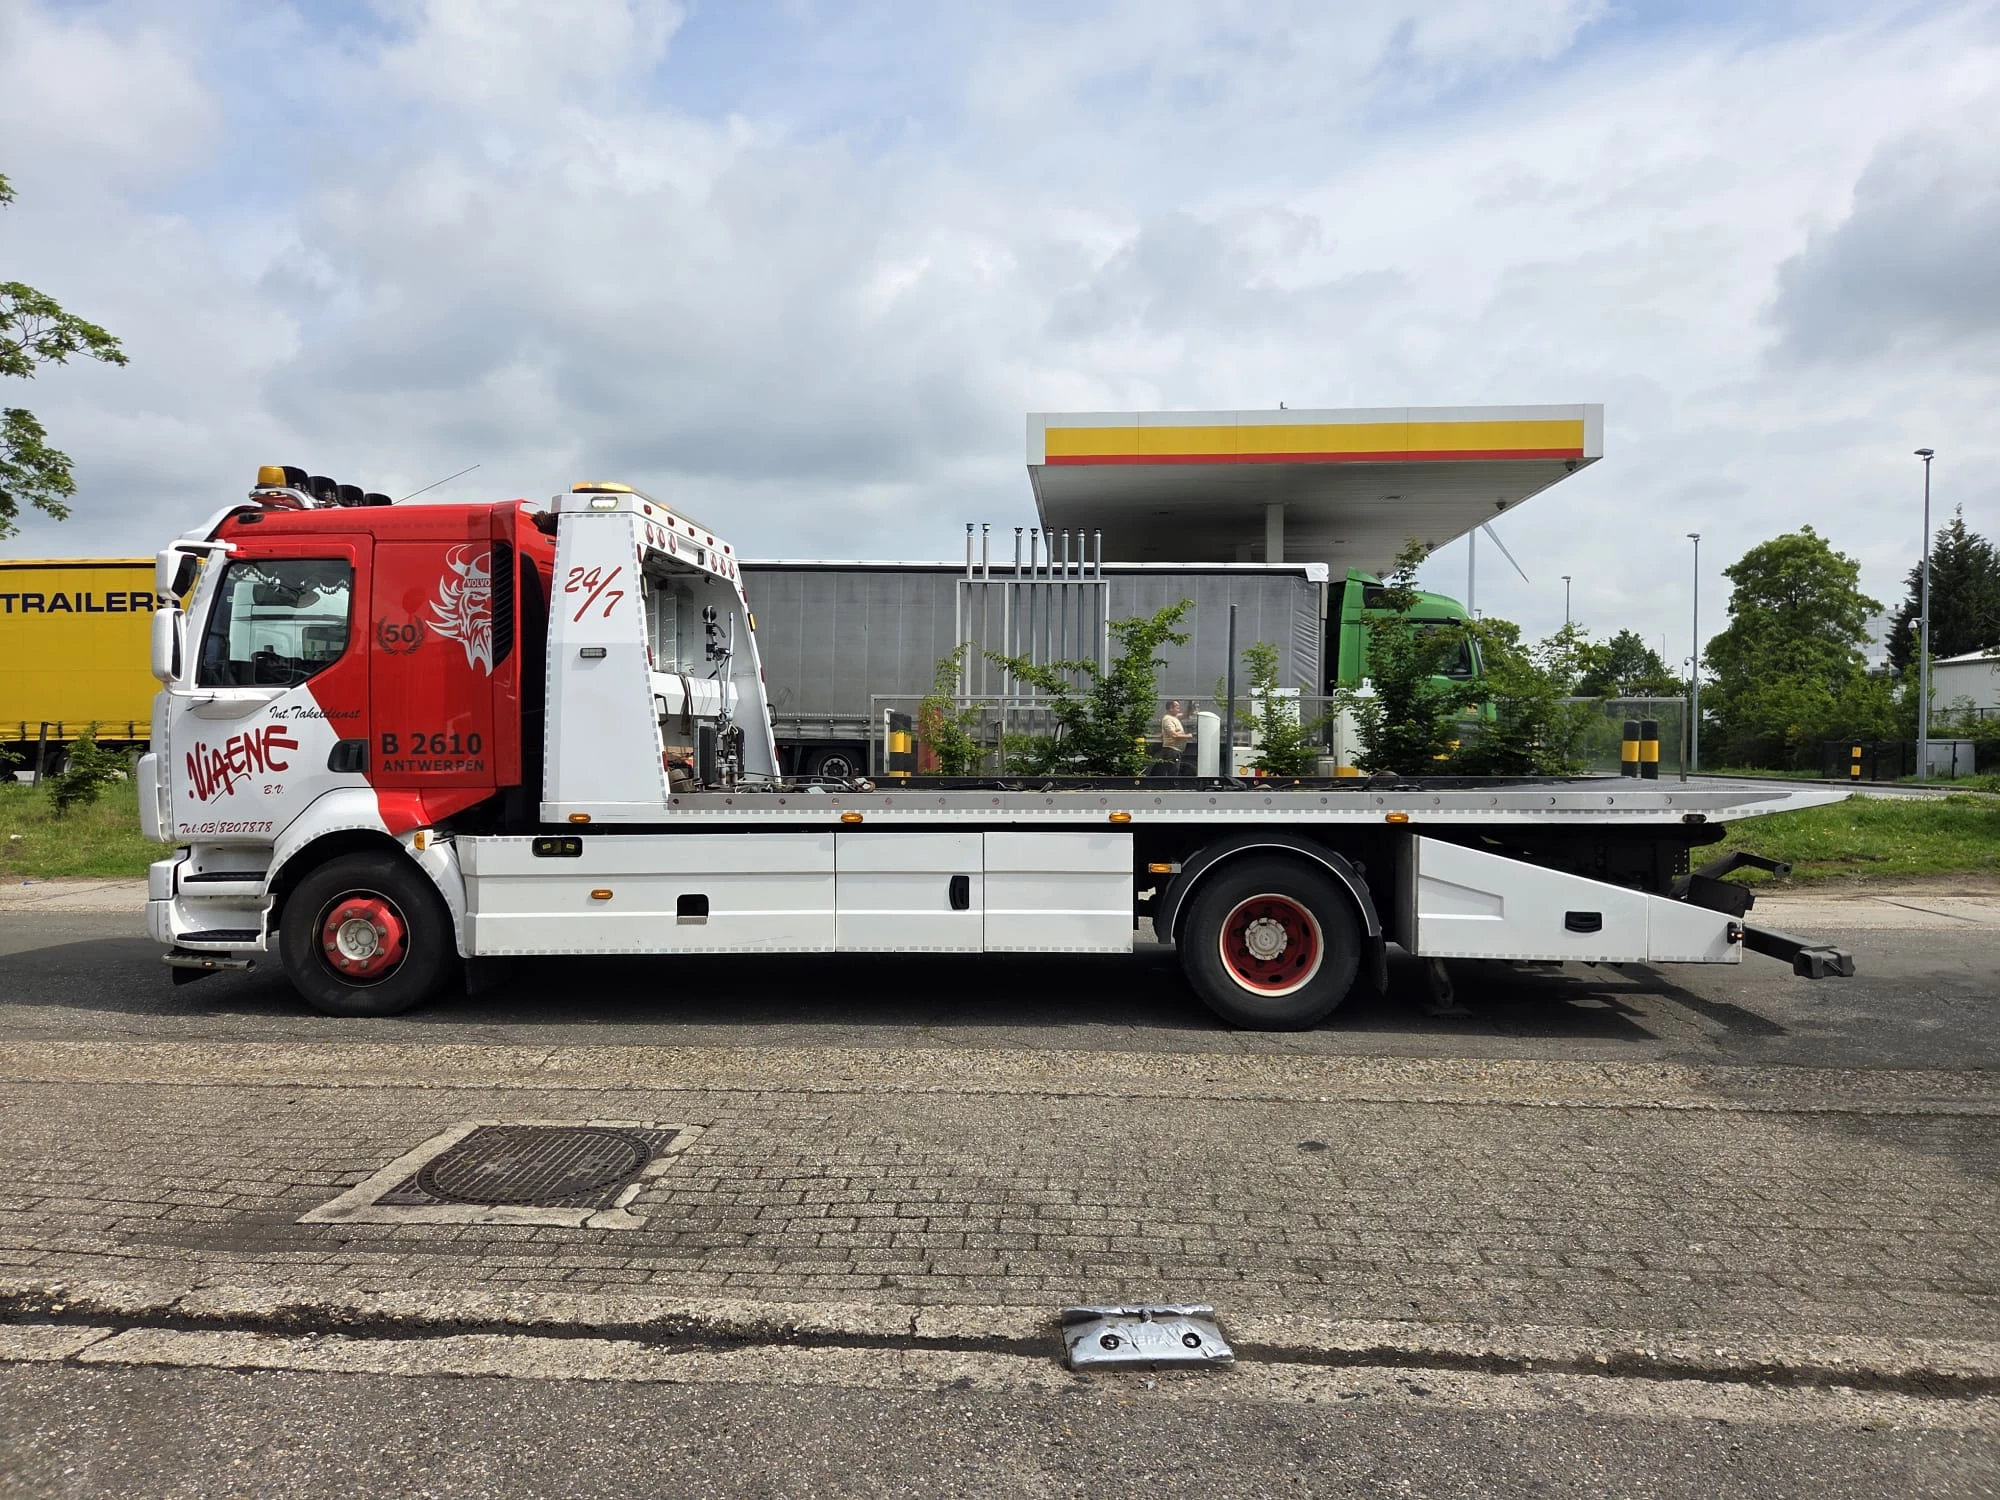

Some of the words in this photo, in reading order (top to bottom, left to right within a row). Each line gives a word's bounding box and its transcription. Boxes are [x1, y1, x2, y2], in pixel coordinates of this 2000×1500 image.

[467, 579, 491, 587] VOLVO
[565, 566, 624, 622] 24/7
[385, 624, 417, 643] 50
[382, 733, 399, 755] B
[411, 733, 483, 755] 2610
[383, 760, 485, 772] ANTWERPEN
